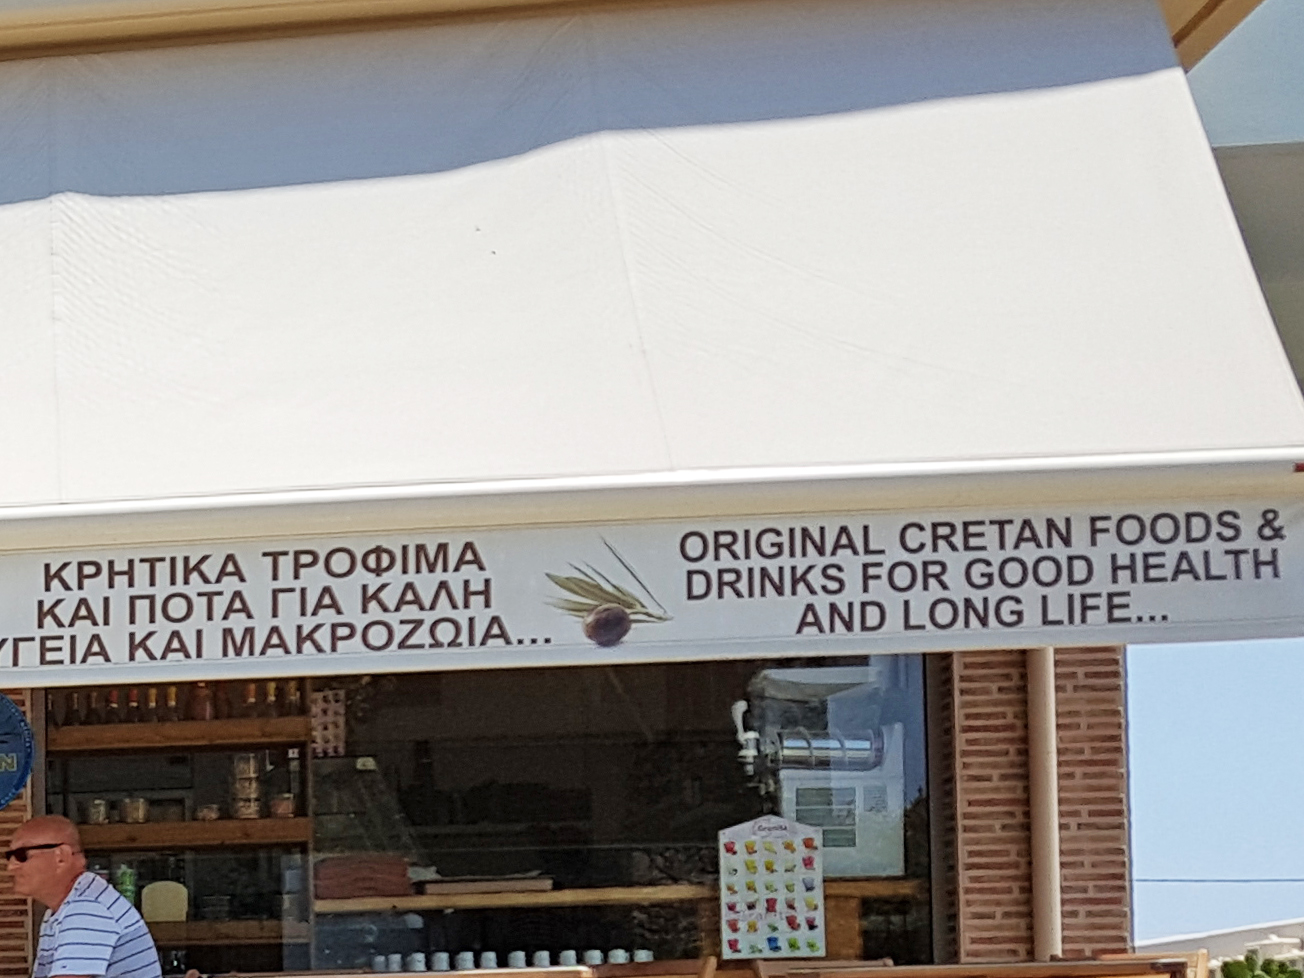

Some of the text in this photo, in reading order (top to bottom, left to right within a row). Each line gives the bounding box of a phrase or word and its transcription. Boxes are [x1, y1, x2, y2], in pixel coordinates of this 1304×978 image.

[680, 510, 1286, 562] ORIGINAL CRETAN FOODS &
[43, 541, 486, 592] ΚΡΗΤΙΚΑ ΤΡΟΦΙΜΑ
[686, 547, 1281, 601] DRINKS FOR GOOD HEALTH
[37, 577, 494, 629] ΚΑΙ ΠΟΤΑ ΓΙΑ ΚΑΛΗ
[796, 591, 1169, 635] AND LONG LIFE...
[129, 628, 203, 661] ΚΑΙ
[221, 614, 552, 658] ΜΑΚΡΟΖΩΙΑ...
